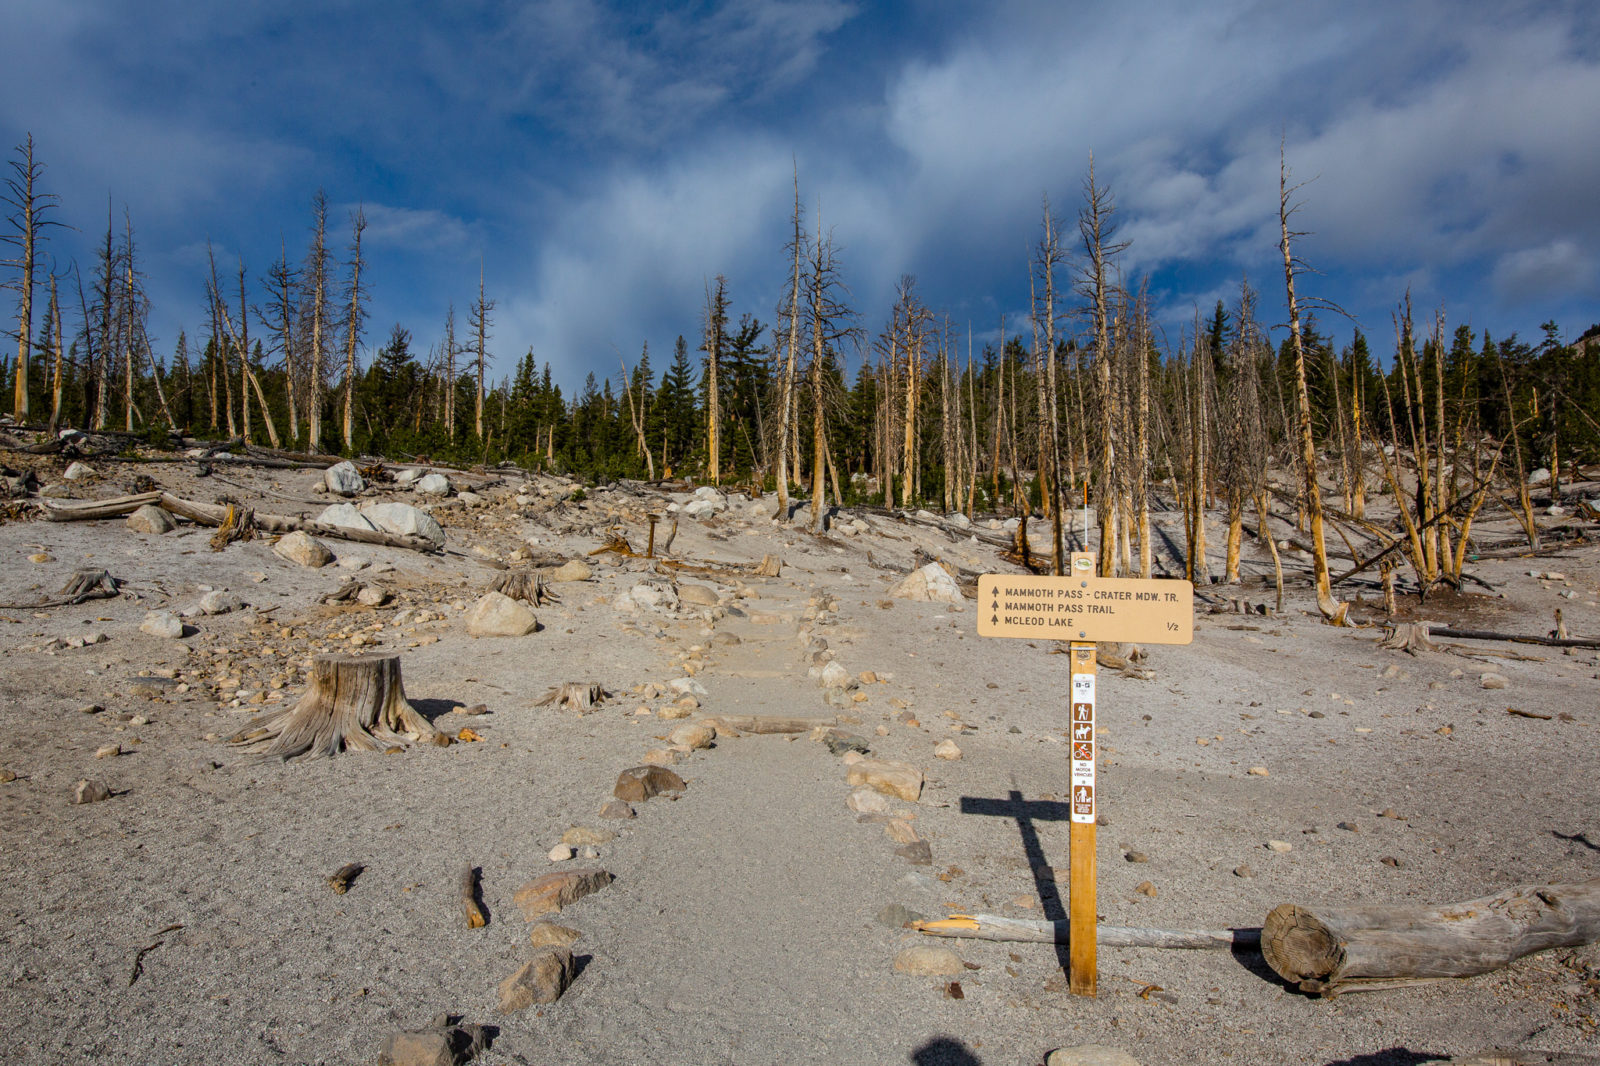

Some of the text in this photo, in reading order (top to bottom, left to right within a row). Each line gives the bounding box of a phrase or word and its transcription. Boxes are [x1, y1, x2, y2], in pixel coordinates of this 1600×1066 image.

[1005, 588, 1054, 598] MAMMOTH
[1057, 589, 1083, 599] PASS
[1093, 591, 1132, 600] CRATER
[1135, 592, 1161, 602] MDW.
[1164, 593, 1179, 602] TR.
[1005, 602, 1115, 614] MAMMOTH PASS TRAIL
[1004, 616, 1073, 627] MCLEOD LAKE
[1167, 622, 1179, 631] 1/2
